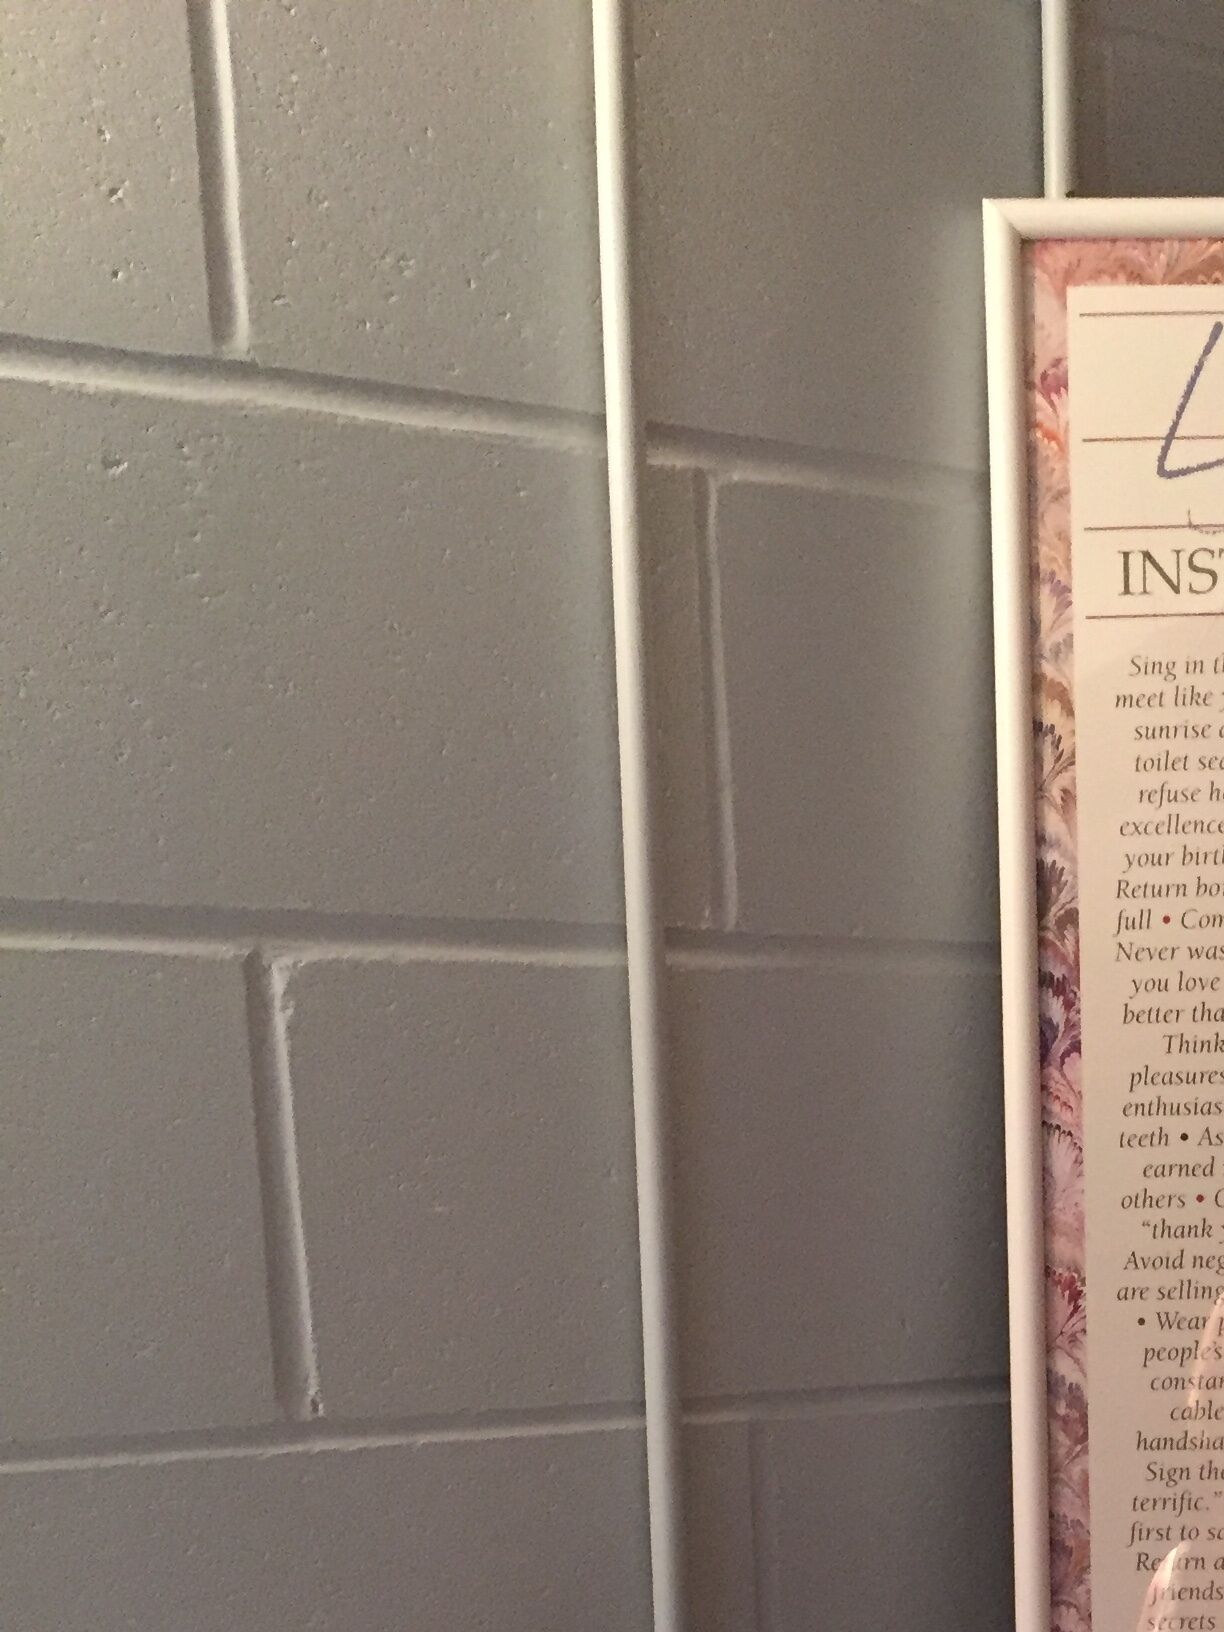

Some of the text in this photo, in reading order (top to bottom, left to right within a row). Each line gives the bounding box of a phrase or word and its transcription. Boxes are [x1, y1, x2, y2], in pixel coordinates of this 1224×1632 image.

[1128, 654, 1177, 682] Sing
[1114, 690, 1165, 709] meet
[1173, 684, 1214, 708] like
[1133, 723, 1212, 741] sunrise
[1134, 749, 1189, 773] toilet
[1138, 781, 1202, 809] refuse
[1121, 852, 1175, 874] your
[1115, 878, 1188, 900] Return
[1113, 907, 1152, 938] full
[1115, 941, 1181, 963] Never
[1177, 969, 1221, 993] love
[1122, 1002, 1185, 1025] better
[1119, 1125, 1170, 1149] teeth
[1142, 1155, 1216, 1179] earned
[1120, 1187, 1186, 1210] others
[1122, 1248, 1185, 1271] Avoid
[1145, 1461, 1191, 1488] Sign
[1127, 1520, 1172, 1548] first
